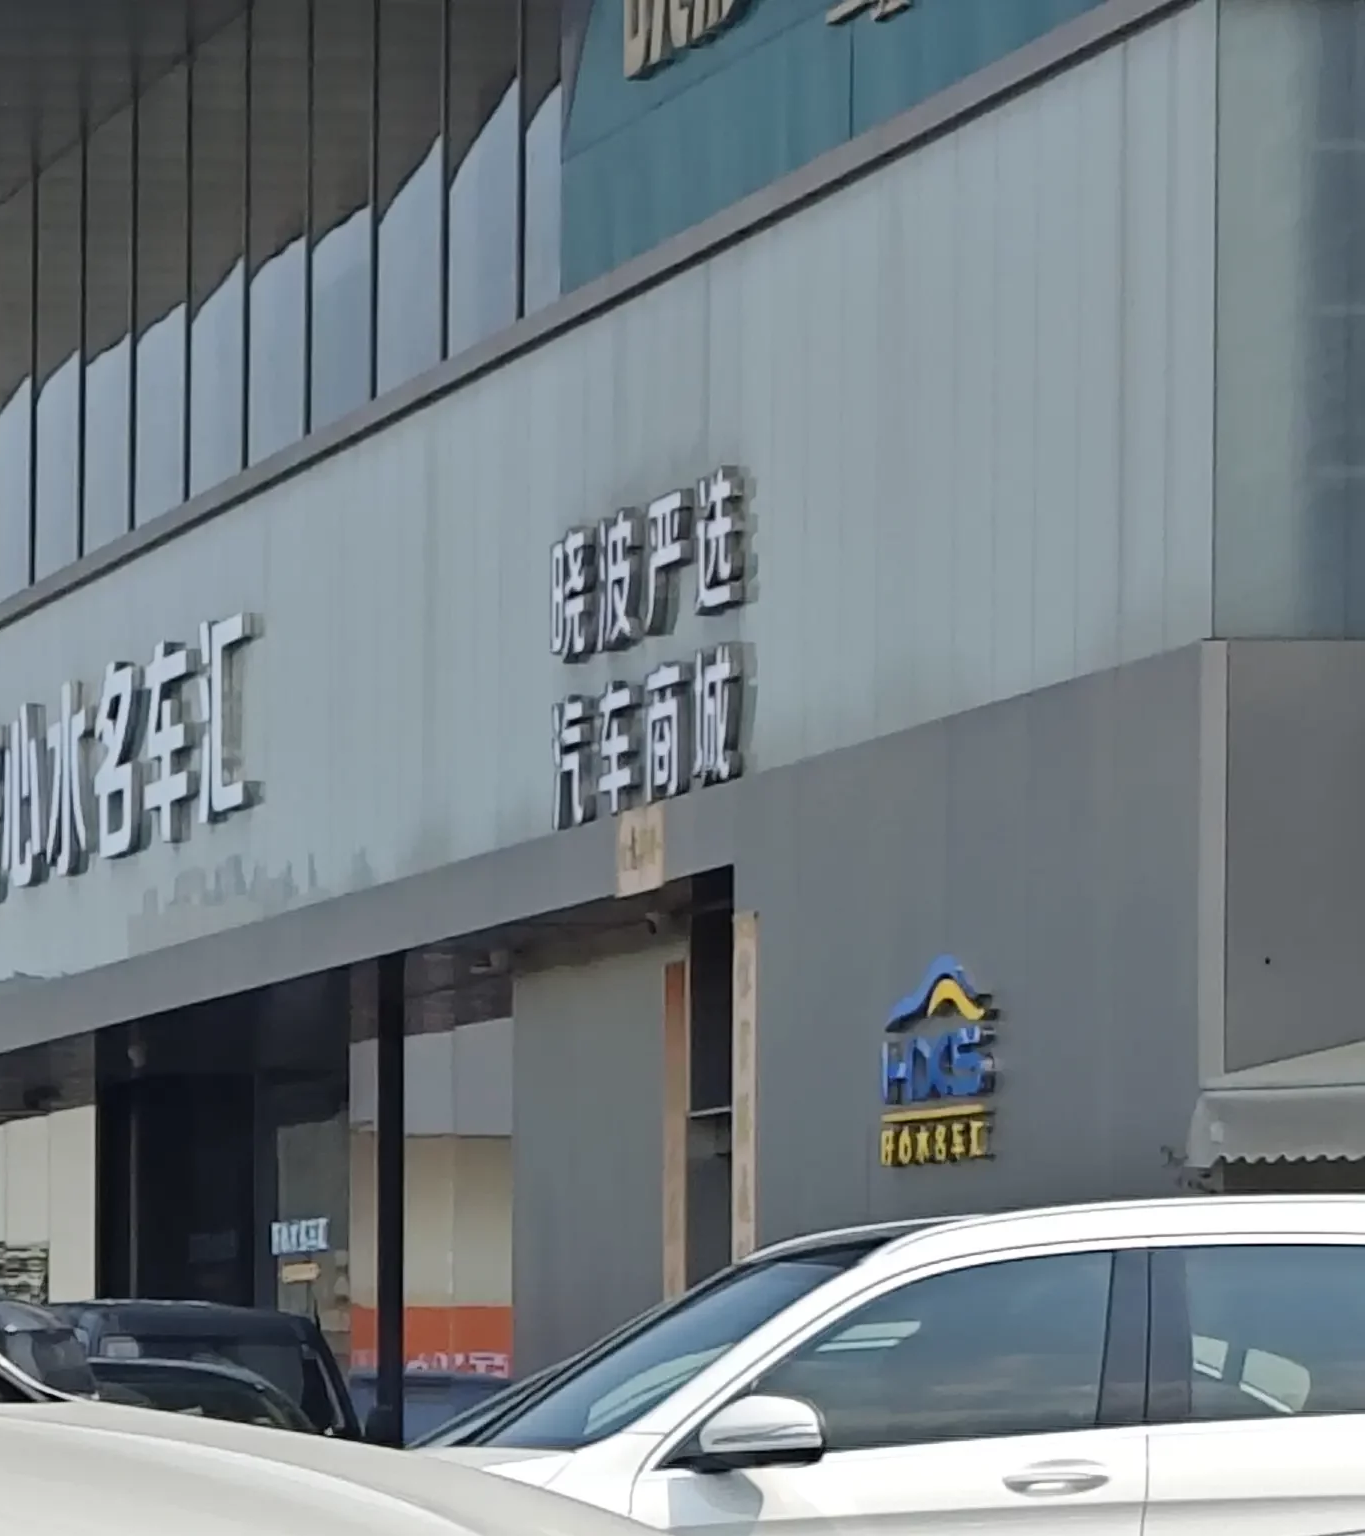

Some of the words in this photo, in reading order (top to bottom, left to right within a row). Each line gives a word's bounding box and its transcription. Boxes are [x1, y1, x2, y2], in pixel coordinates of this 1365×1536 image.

[549, 466, 739, 662] 晓波严选
[552, 644, 735, 831] 汽车商城
